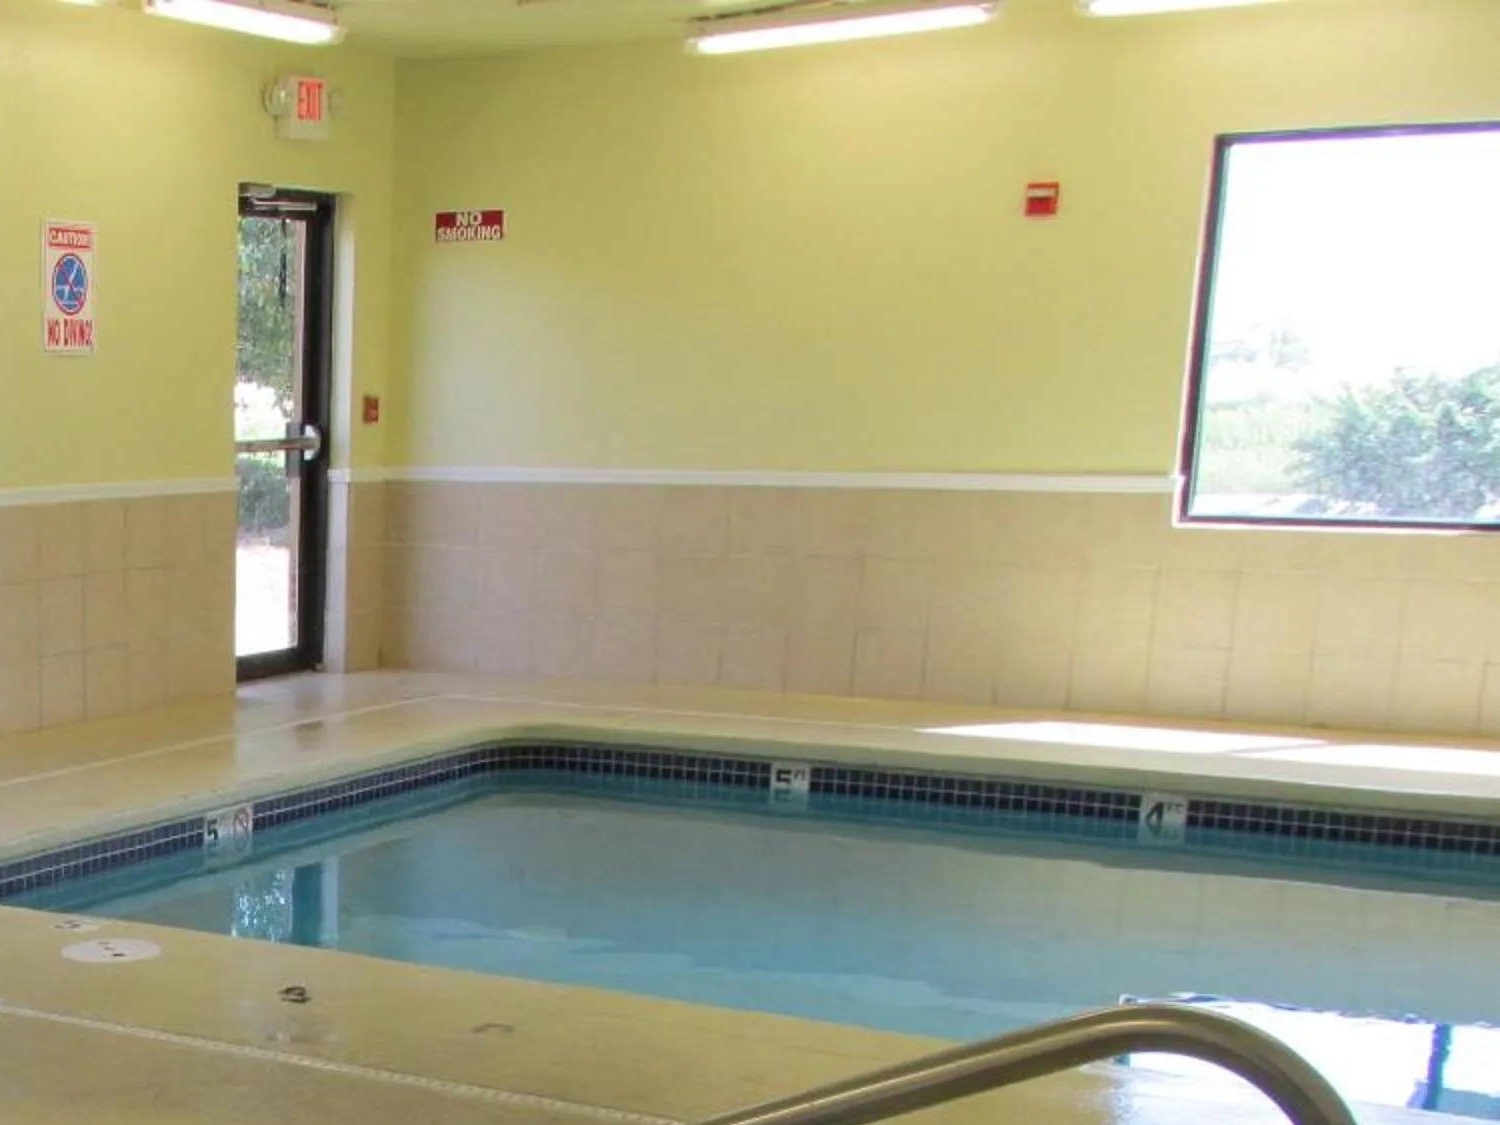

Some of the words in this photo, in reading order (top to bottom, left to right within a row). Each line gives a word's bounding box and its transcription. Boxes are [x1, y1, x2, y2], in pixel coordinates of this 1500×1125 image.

[297, 81, 323, 121] EXIT
[455, 211, 483, 226] NO
[437, 224, 501, 242] SMOKING
[47, 318, 61, 347] NO
